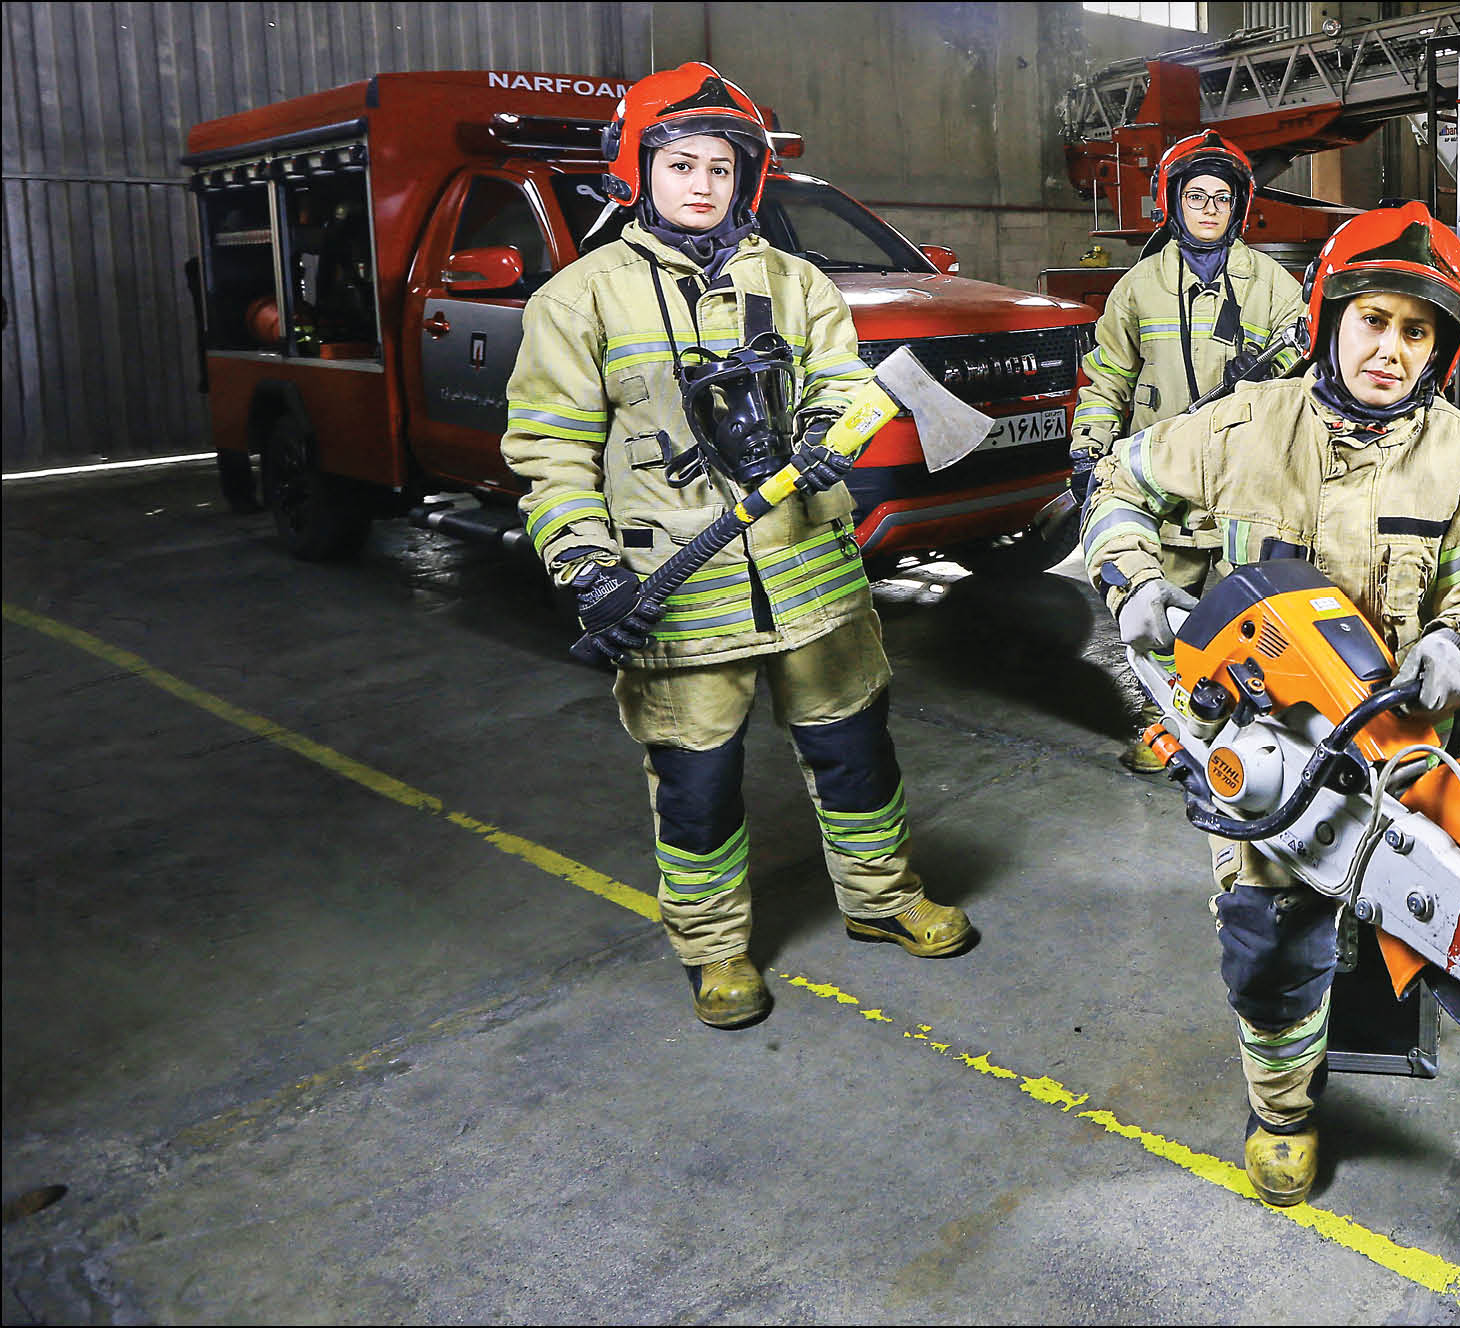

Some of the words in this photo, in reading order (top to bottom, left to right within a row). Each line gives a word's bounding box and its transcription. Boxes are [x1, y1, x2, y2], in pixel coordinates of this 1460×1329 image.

[1008, 415, 1040, 443] ۱۶۸
[1043, 417, 1065, 439] ۶۸
[1211, 755, 1240, 784] STIHL
